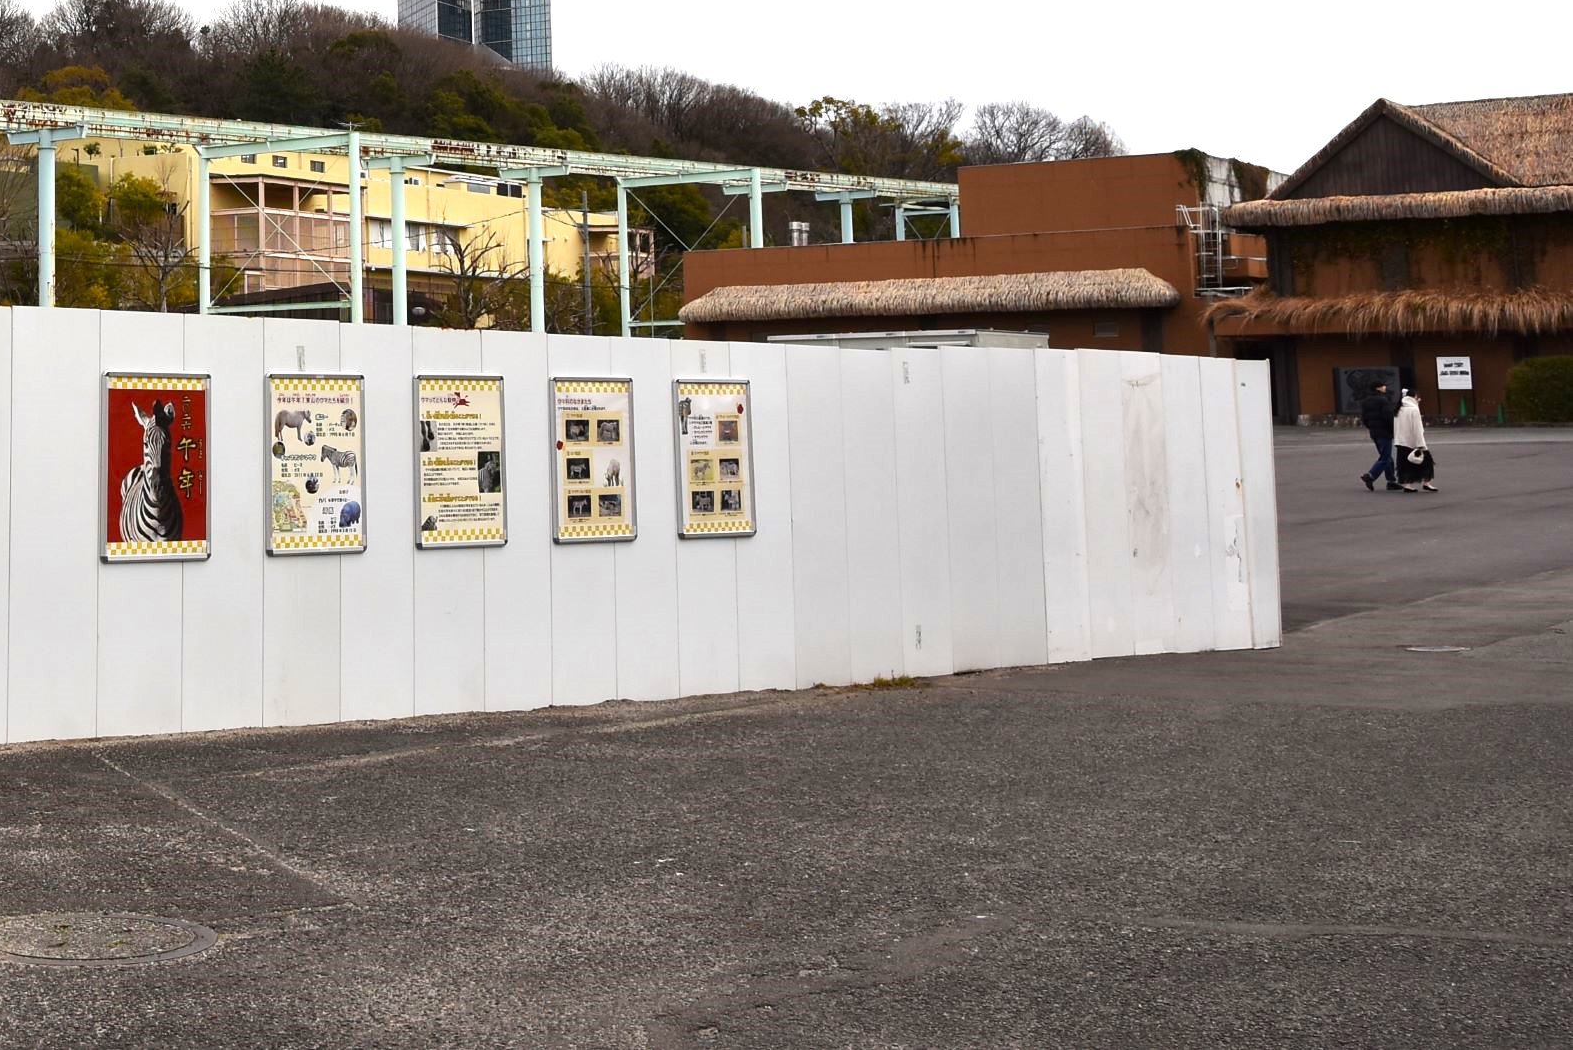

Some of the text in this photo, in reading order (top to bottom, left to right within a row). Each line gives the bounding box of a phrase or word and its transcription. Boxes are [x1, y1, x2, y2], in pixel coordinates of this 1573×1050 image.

[180, 396, 192, 431] 二〇二六
[176, 437, 196, 499] 午年
